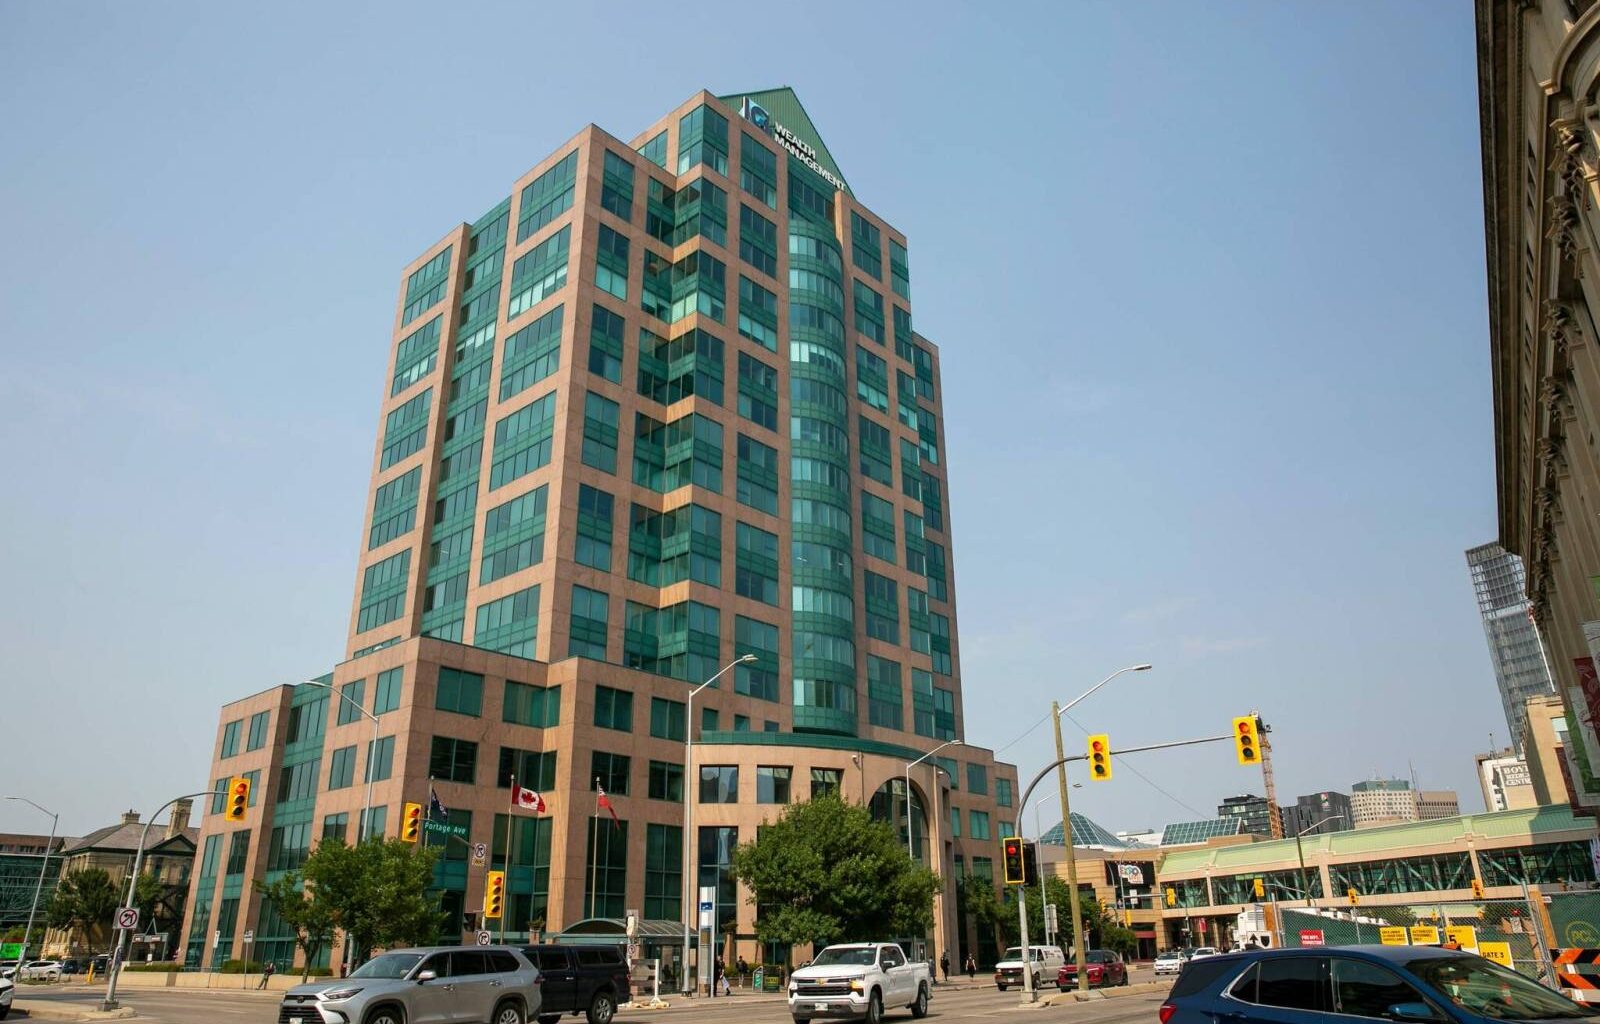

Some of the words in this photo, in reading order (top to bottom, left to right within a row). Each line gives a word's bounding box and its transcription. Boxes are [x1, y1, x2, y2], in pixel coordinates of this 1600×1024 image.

[775, 122, 816, 159] WEALTH
[775, 134, 845, 190] MANAGEMENT
[425, 822, 451, 833] Portage
[454, 826, 466, 834] Ave
[1448, 934, 1457, 943] 5
